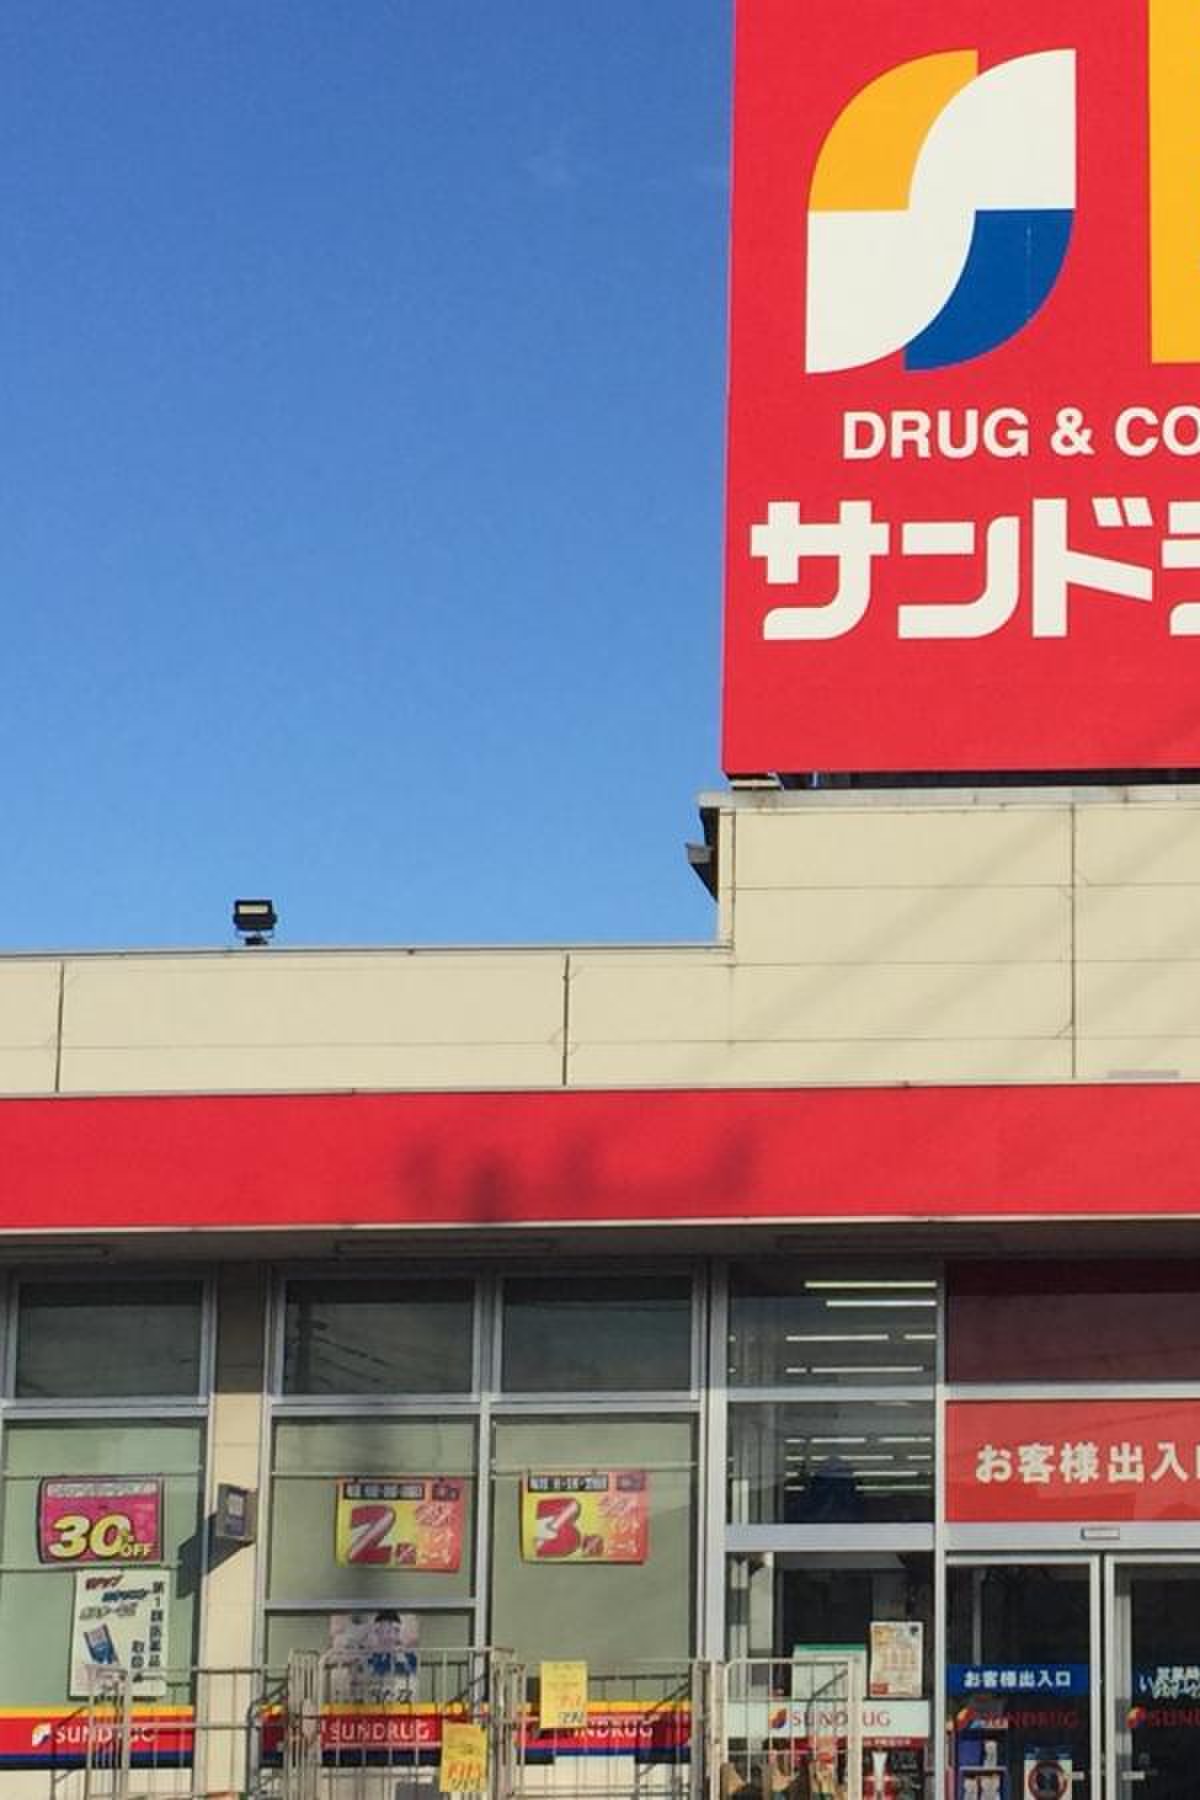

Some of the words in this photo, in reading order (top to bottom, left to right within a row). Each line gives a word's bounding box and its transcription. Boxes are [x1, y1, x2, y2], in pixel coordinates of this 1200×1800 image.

[842, 407, 1029, 459] DRUG
[1050, 407, 1094, 456] &
[963, 1669, 1072, 1689] お客様出入口
[789, 1711, 892, 1728] SUNDUG
[54, 1724, 157, 1744] SUNDG
[329, 1719, 431, 1741] SUNDRUG
